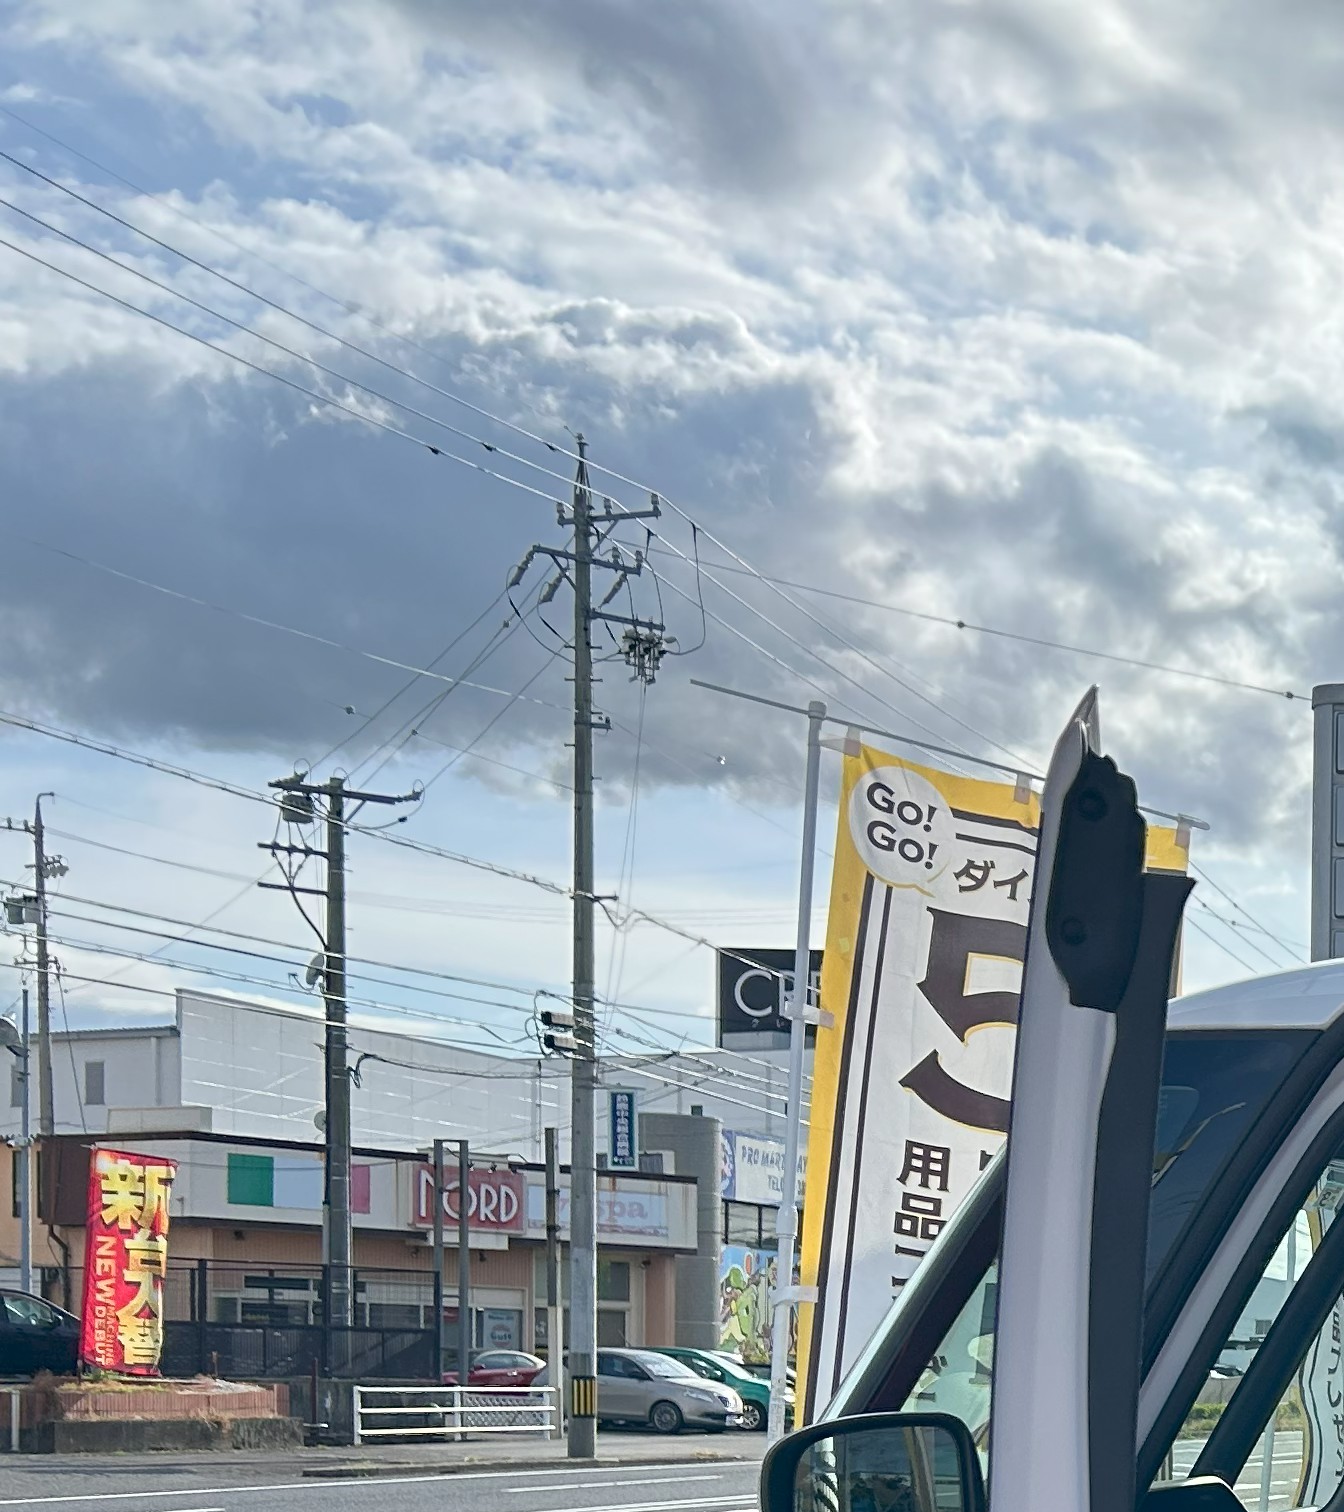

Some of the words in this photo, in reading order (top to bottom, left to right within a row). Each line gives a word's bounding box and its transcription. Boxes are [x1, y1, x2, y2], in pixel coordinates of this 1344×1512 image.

[866, 781, 937, 833] GO!
[866, 820, 939, 870] GO!
[952, 858, 1032, 903] ダイ
[419, 1168, 519, 1224] NORD
[95, 1234, 117, 1306] NEW
[94, 1305, 107, 1367] DEBUT
